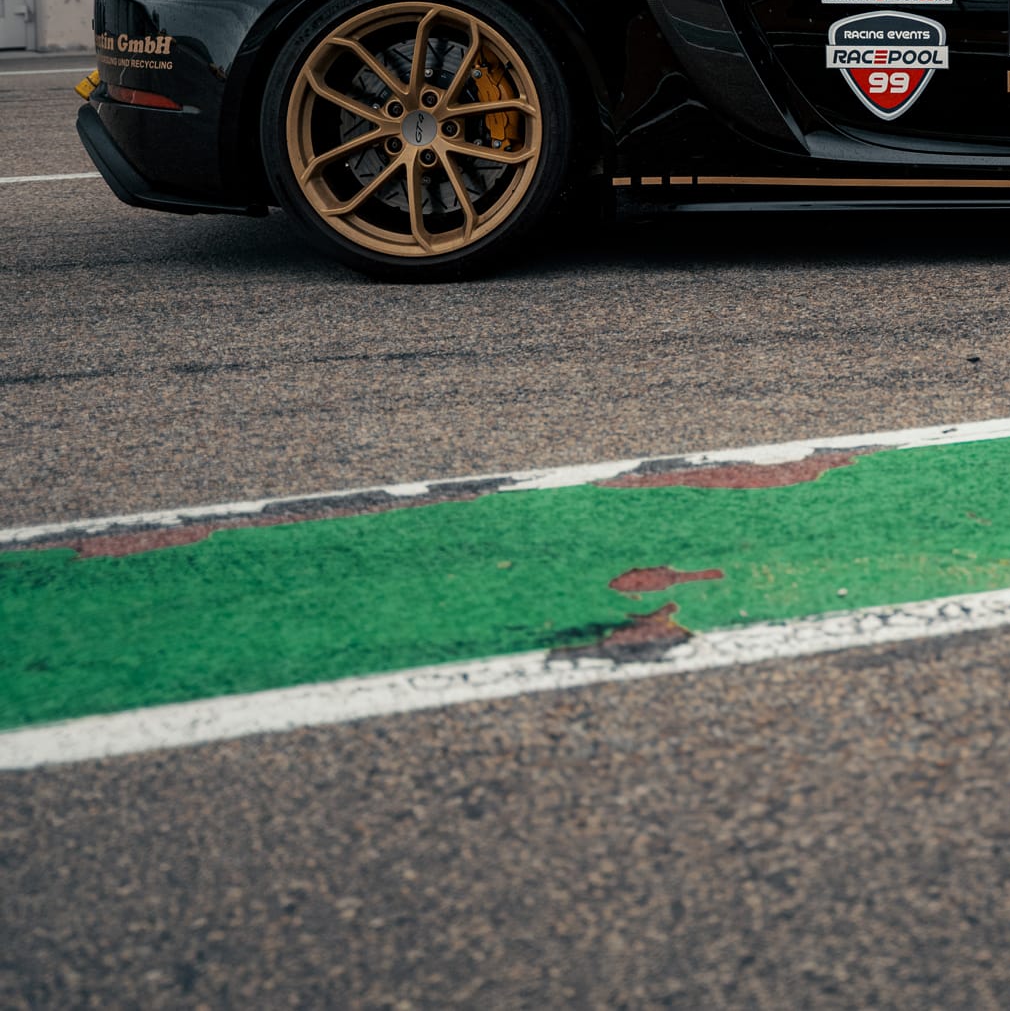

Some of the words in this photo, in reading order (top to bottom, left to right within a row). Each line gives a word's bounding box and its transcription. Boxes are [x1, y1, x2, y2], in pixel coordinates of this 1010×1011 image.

[844, 30, 884, 40] RACING
[117, 33, 172, 55] GmbH
[130, 58, 173, 70] RECYCLING
[832, 49, 943, 65] RACEPOOL
[868, 72, 910, 94] 99
